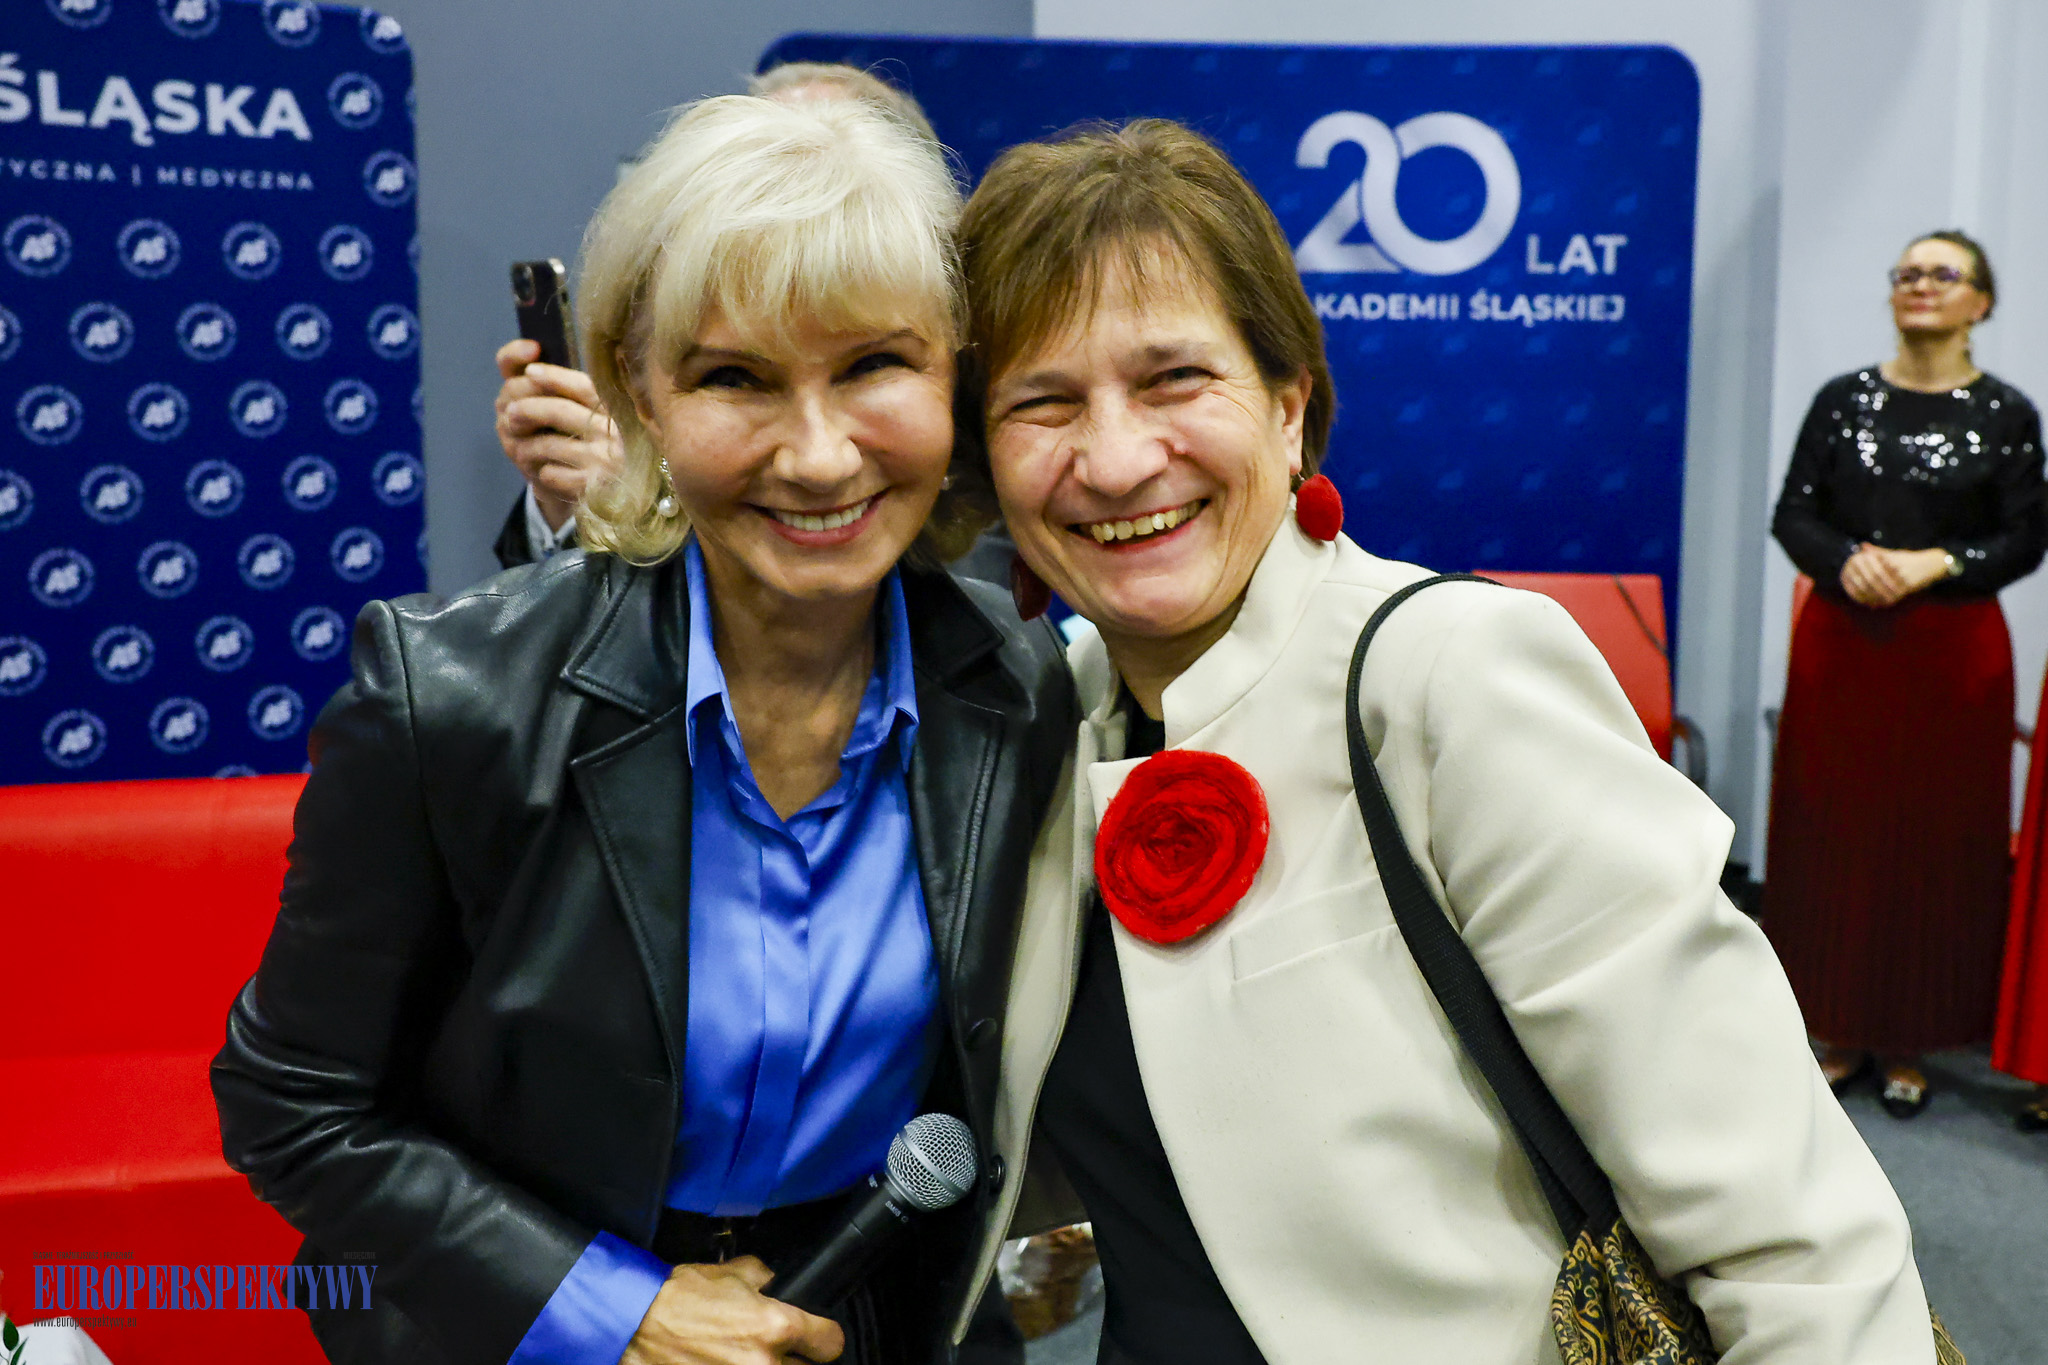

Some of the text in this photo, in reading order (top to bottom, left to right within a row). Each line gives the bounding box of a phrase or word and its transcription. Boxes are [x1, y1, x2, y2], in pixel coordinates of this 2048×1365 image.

[0, 53, 313, 147] ŚLĄSKA
[157, 165, 314, 191] MEDYCZNA
[1295, 110, 1629, 275] 20 LAT
[1469, 288, 1626, 328] ŚLĄSKIEJ
